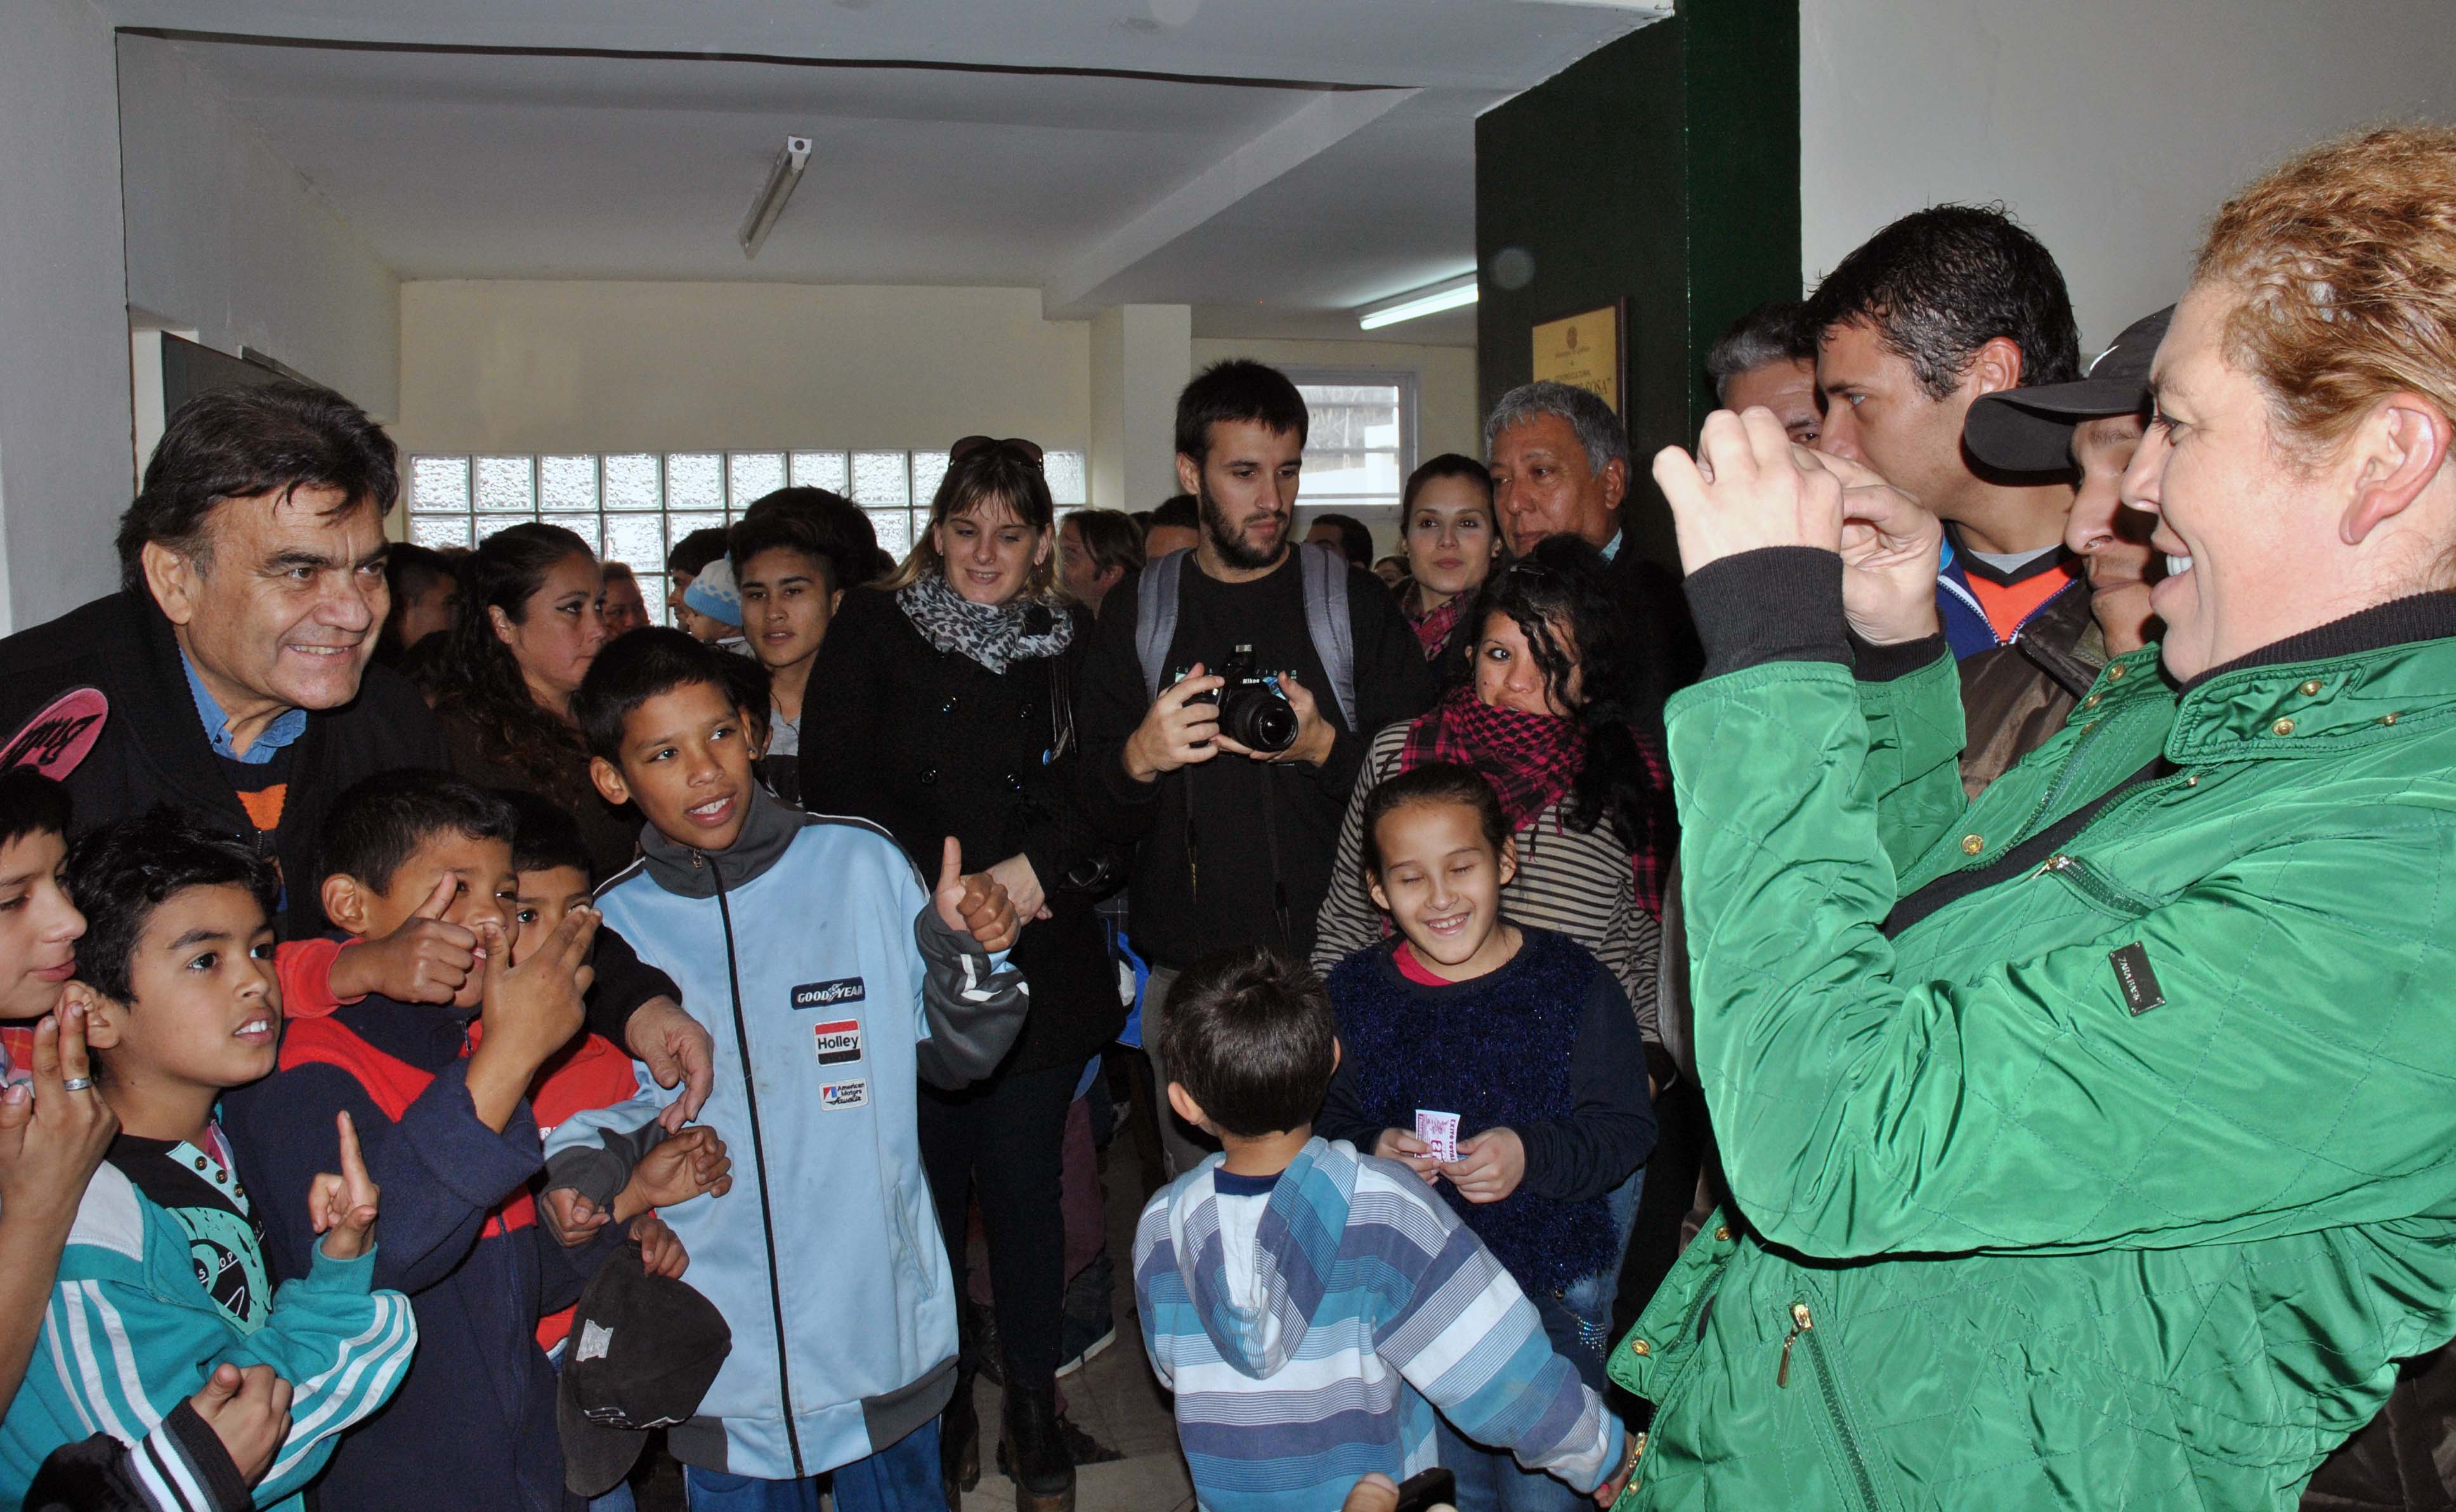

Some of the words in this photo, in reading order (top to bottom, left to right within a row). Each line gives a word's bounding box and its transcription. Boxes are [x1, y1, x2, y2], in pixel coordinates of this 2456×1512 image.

[2118, 956, 2132, 980] ZARA
[2127, 979, 2142, 1003] BASIC
[818, 1035, 859, 1050] Holley
[837, 1083, 865, 1092] American
